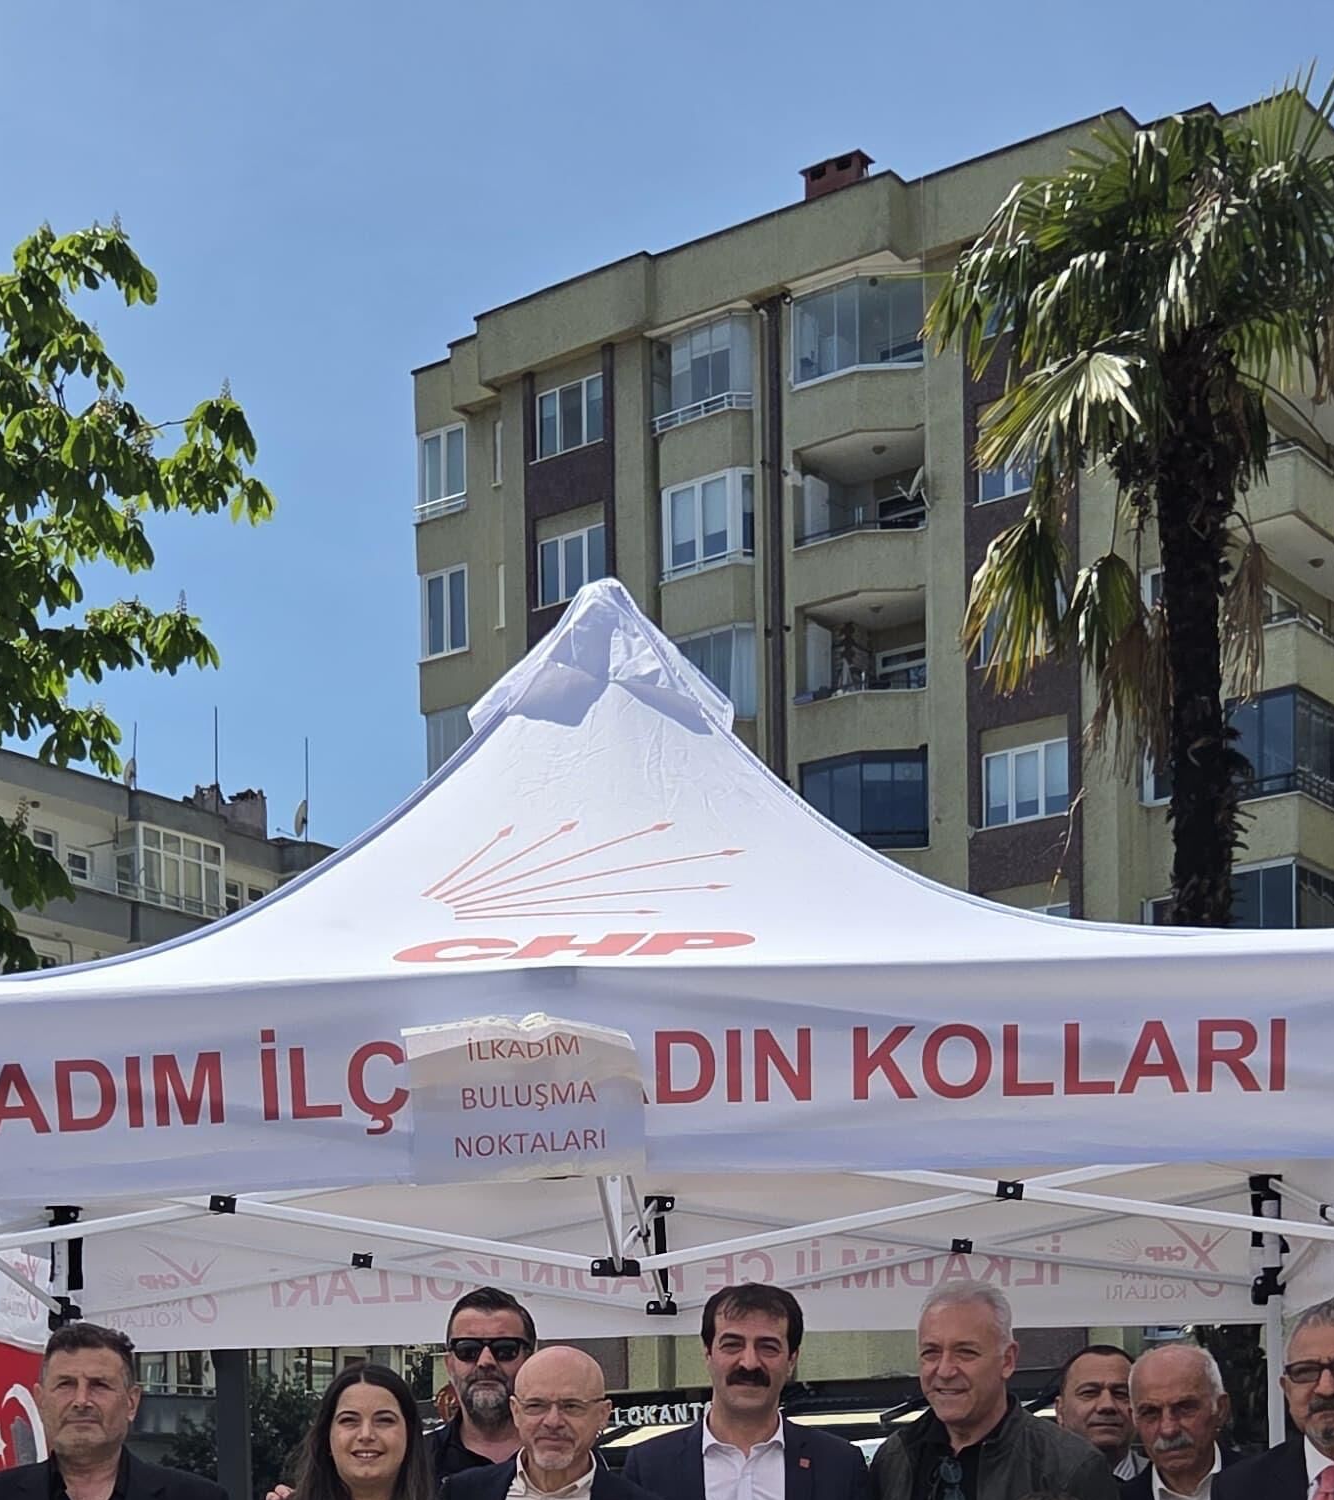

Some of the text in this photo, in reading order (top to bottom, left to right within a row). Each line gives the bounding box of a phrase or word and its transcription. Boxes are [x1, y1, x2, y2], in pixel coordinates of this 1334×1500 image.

[392, 931, 756, 964] CHP
[466, 1033, 582, 1063] İLKADIM
[259, 1028, 409, 1136] İLÇ
[641, 1026, 813, 1107] DIN
[852, 1018, 1288, 1102] KOLLARI
[460, 1078, 598, 1112] BULUŞMA
[454, 1128, 607, 1159] NOKTALARI
